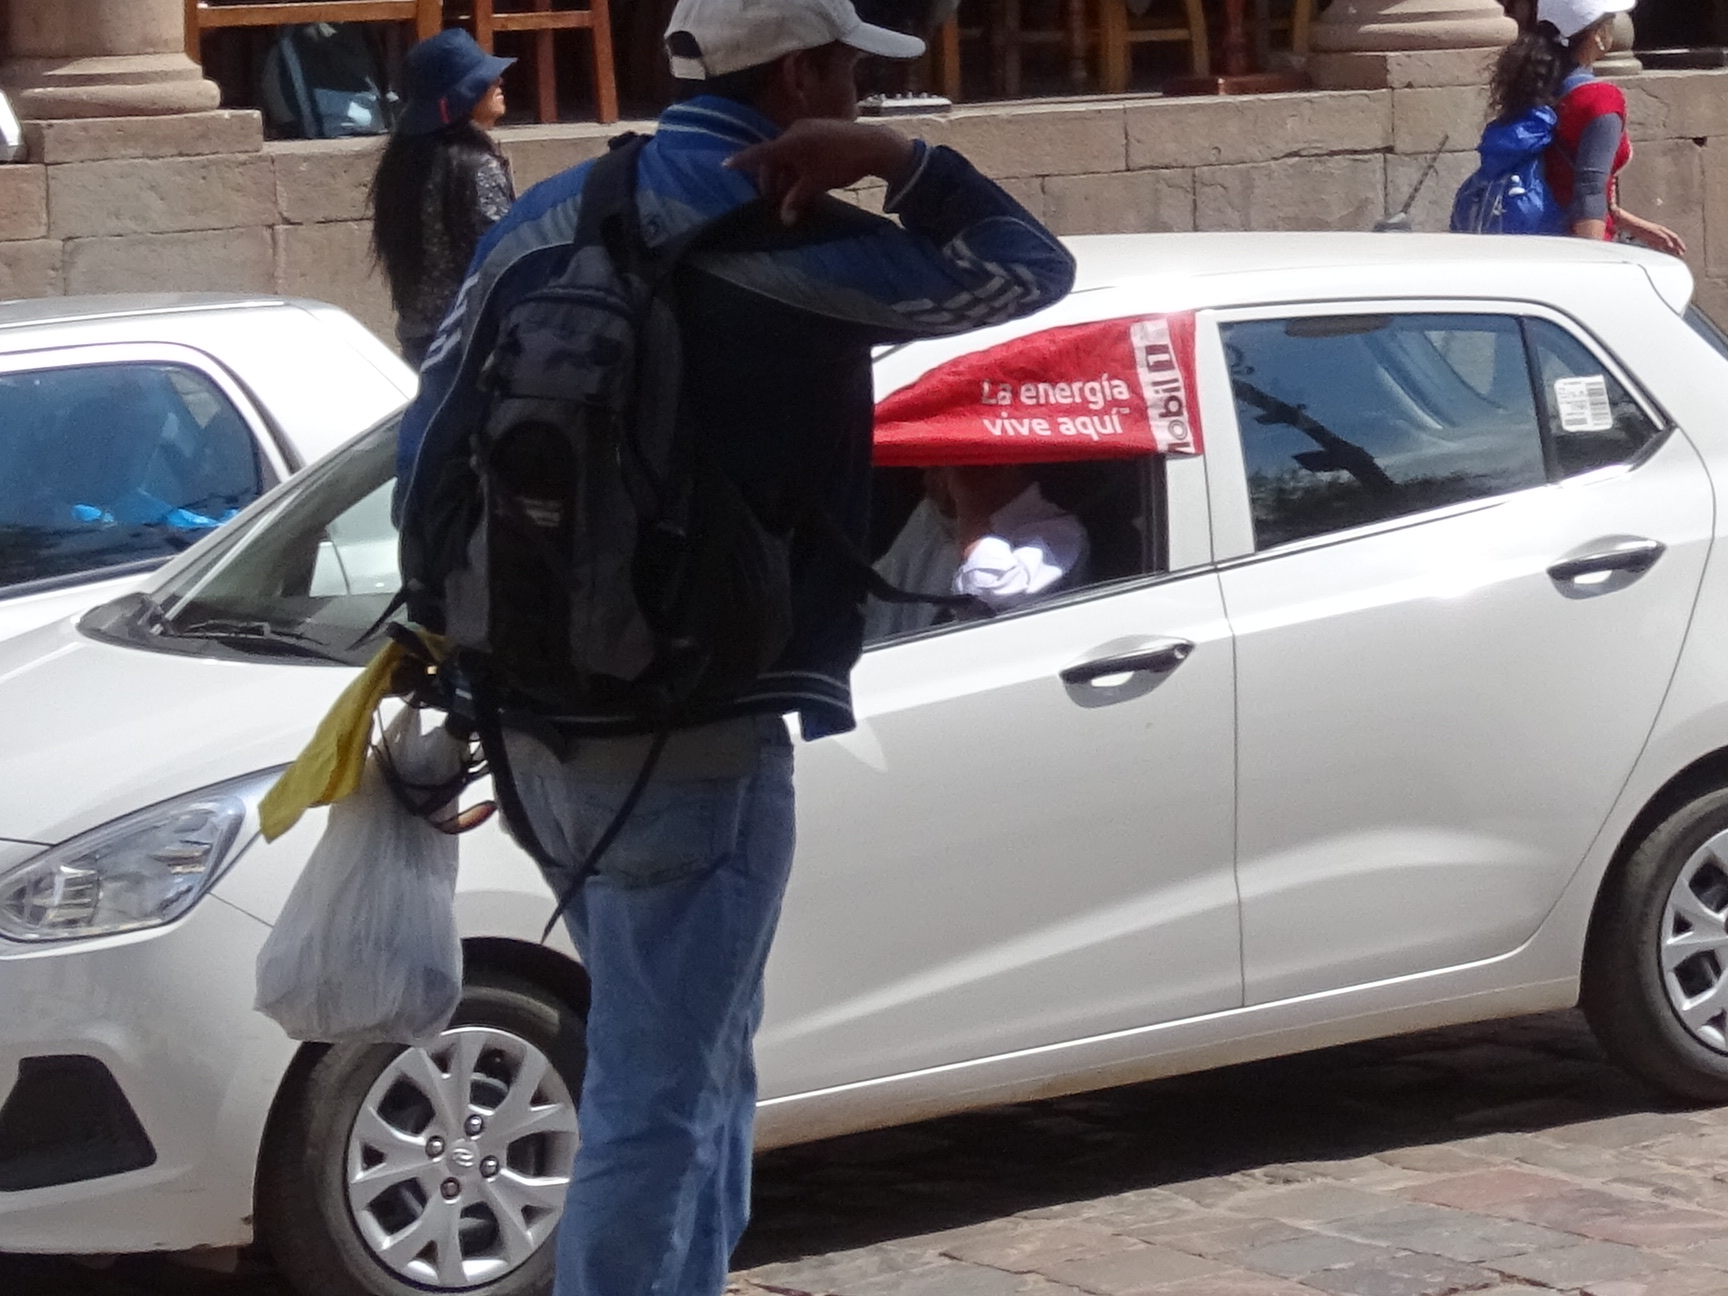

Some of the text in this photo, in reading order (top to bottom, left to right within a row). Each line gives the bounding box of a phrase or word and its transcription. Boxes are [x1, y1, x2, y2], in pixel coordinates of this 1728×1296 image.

[981, 373, 1130, 410] La energía
[983, 408, 1124, 442] vive aquí
